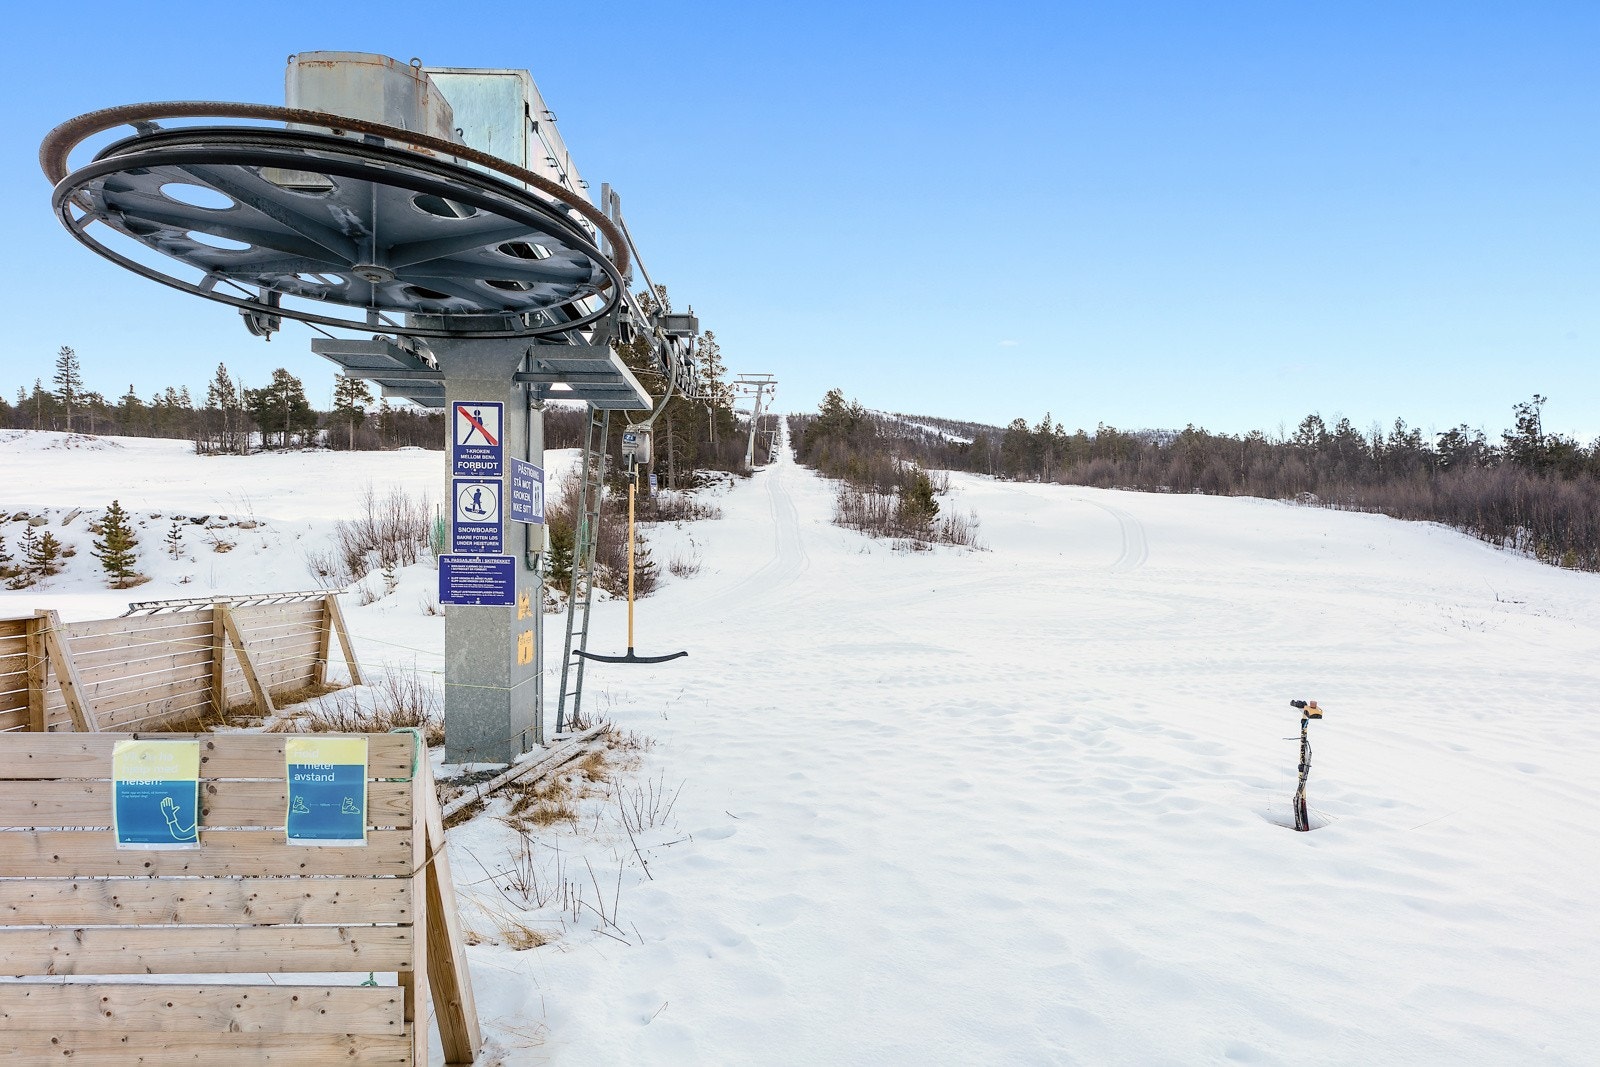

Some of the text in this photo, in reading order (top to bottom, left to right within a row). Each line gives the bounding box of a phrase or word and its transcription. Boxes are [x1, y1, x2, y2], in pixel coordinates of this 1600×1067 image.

[458, 462, 498, 470] FORBUDT
[518, 462, 540, 480] PÅSTIGNING
[513, 476, 531, 490] STÅ MOT
[512, 502, 532, 514] IKKE SITT
[294, 772, 335, 782] avstand
